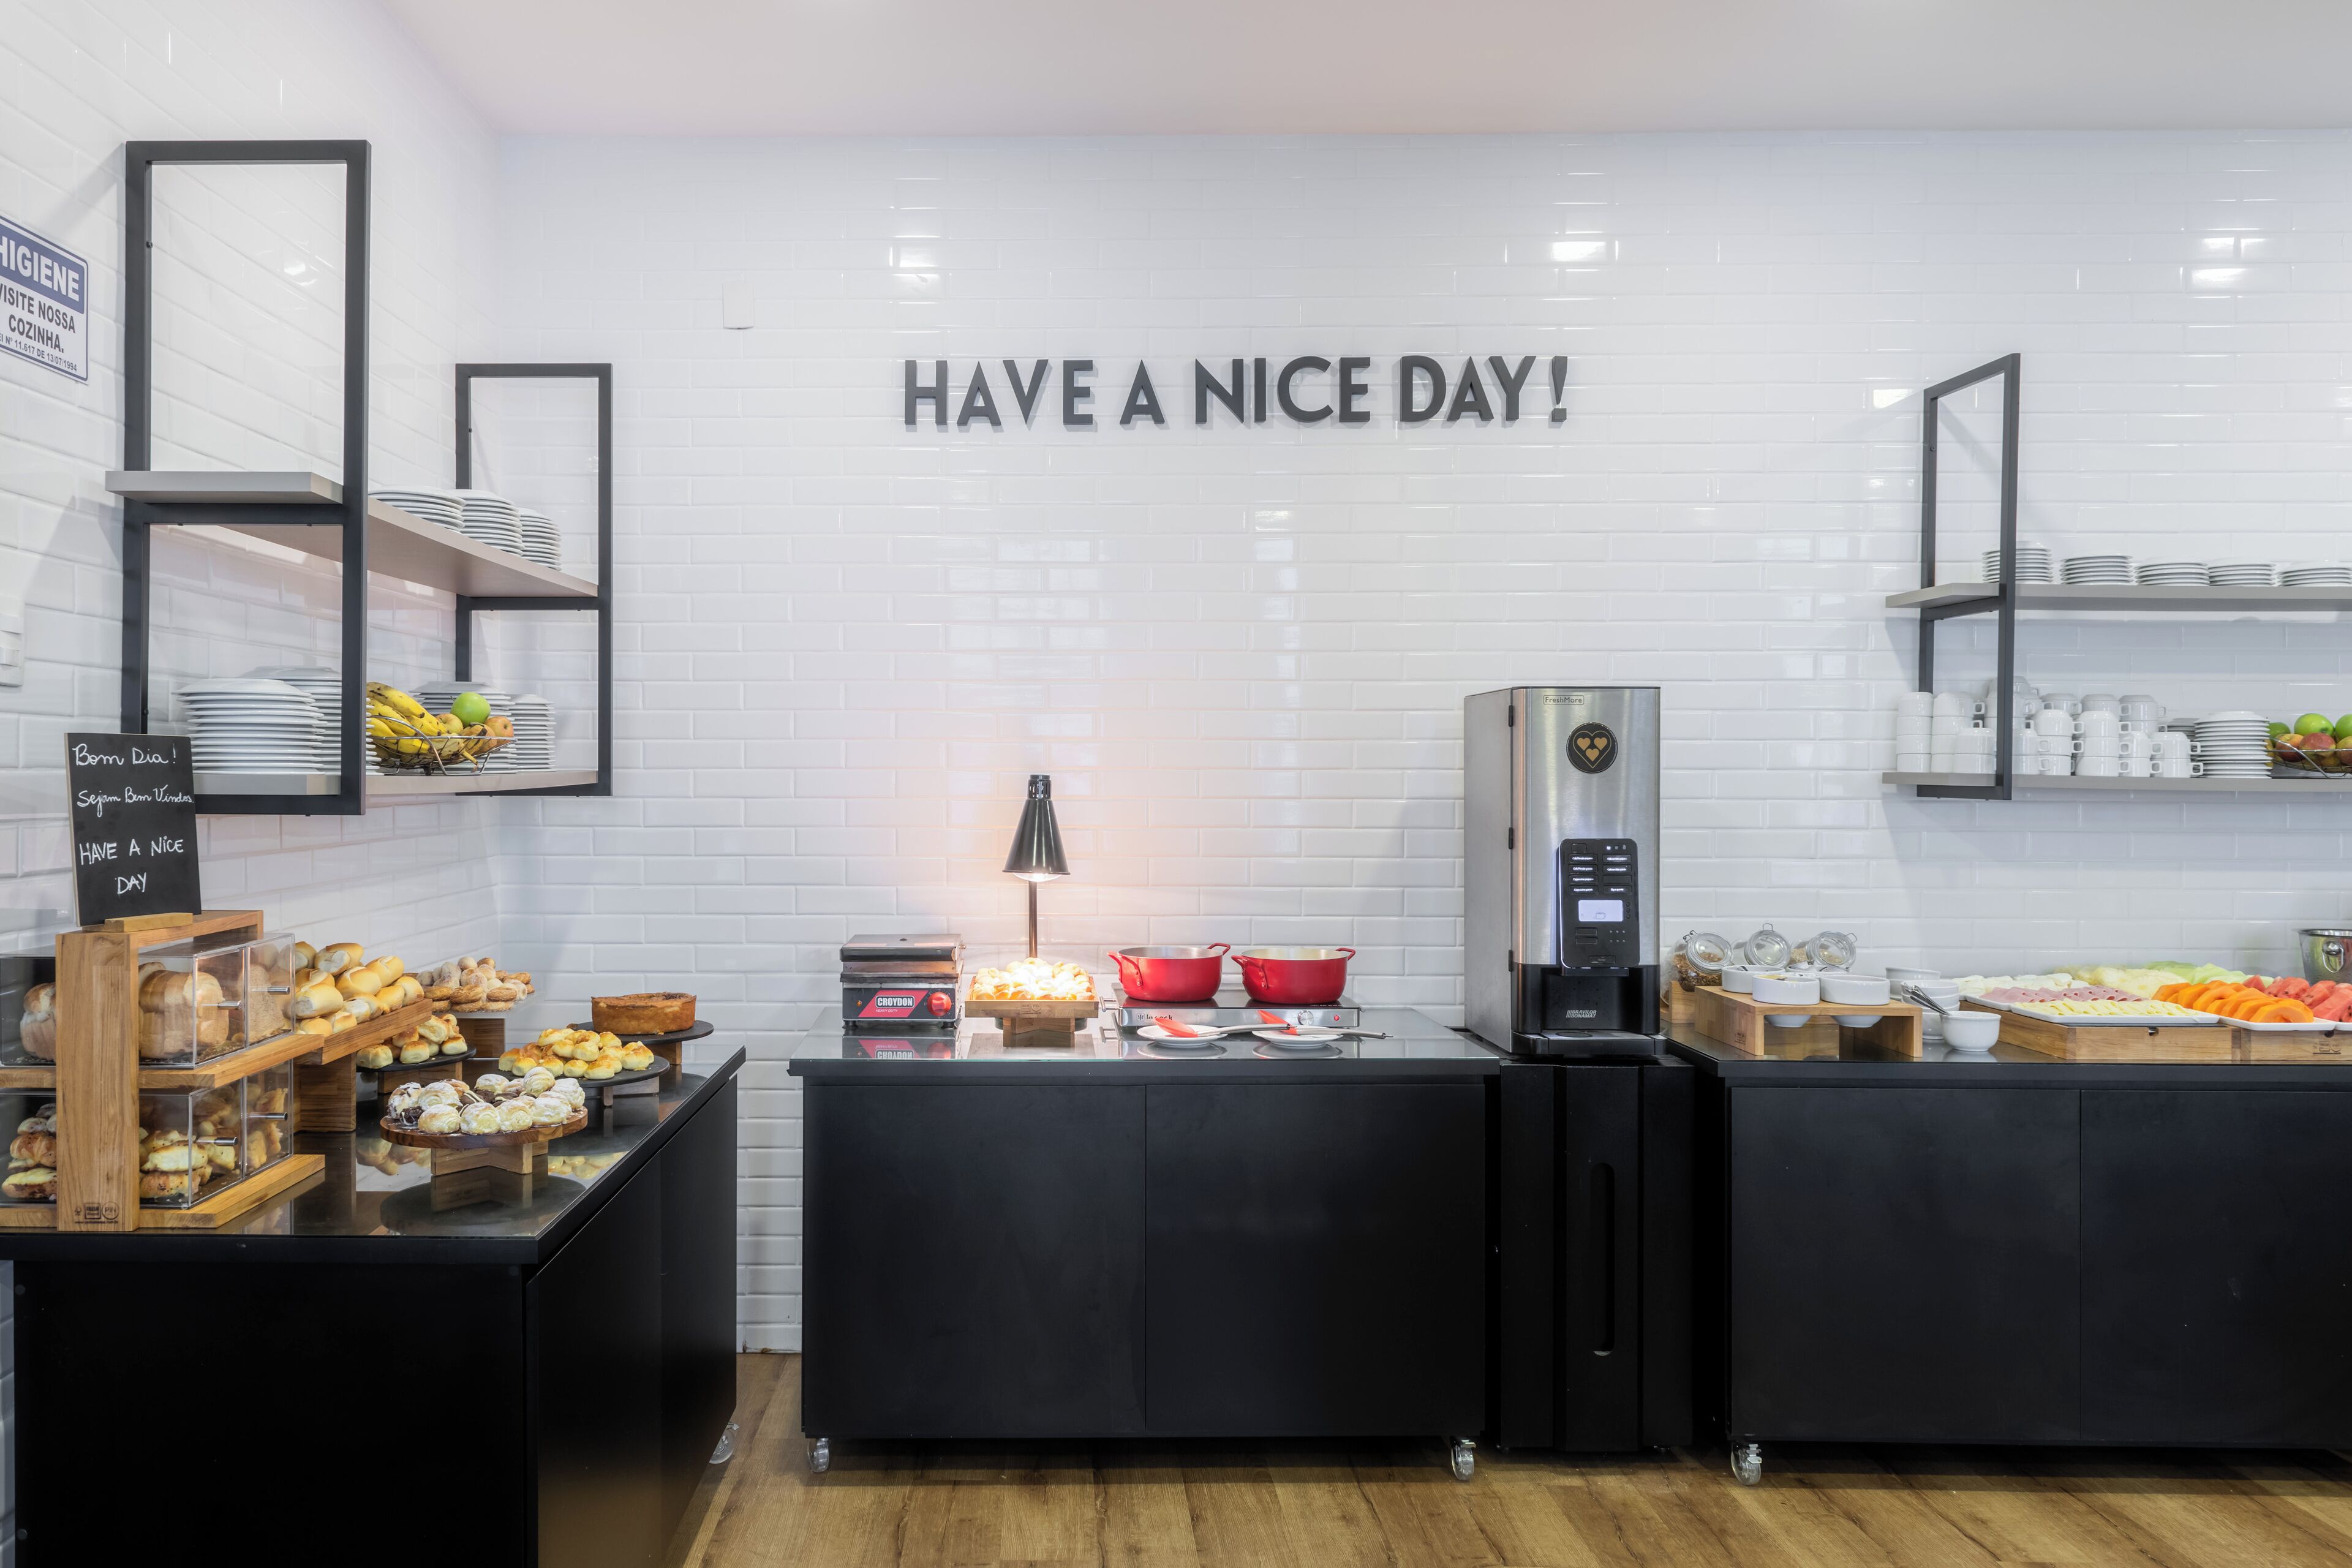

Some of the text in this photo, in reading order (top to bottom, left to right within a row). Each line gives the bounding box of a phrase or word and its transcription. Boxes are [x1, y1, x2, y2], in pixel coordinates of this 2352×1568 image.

[39, 300, 75, 334] NOSSA
[9, 314, 64, 353] COZINHA.
[15, 339, 35, 355] 11.617
[37, 349, 45, 359] DE
[47, 352, 77, 372] 13/07/1994
[905, 359, 1093, 426] HAVE
[1120, 359, 1165, 425] A
[1195, 355, 1371, 424] NICE
[72, 743, 124, 766] Bom
[77, 790, 121, 817] Sejam
[125, 786, 151, 803] Bem
[79, 842, 118, 865] HAVE
[129, 839, 141, 856] A
[116, 872, 146, 894] DAY
[877, 997, 913, 1006] CROYDON
